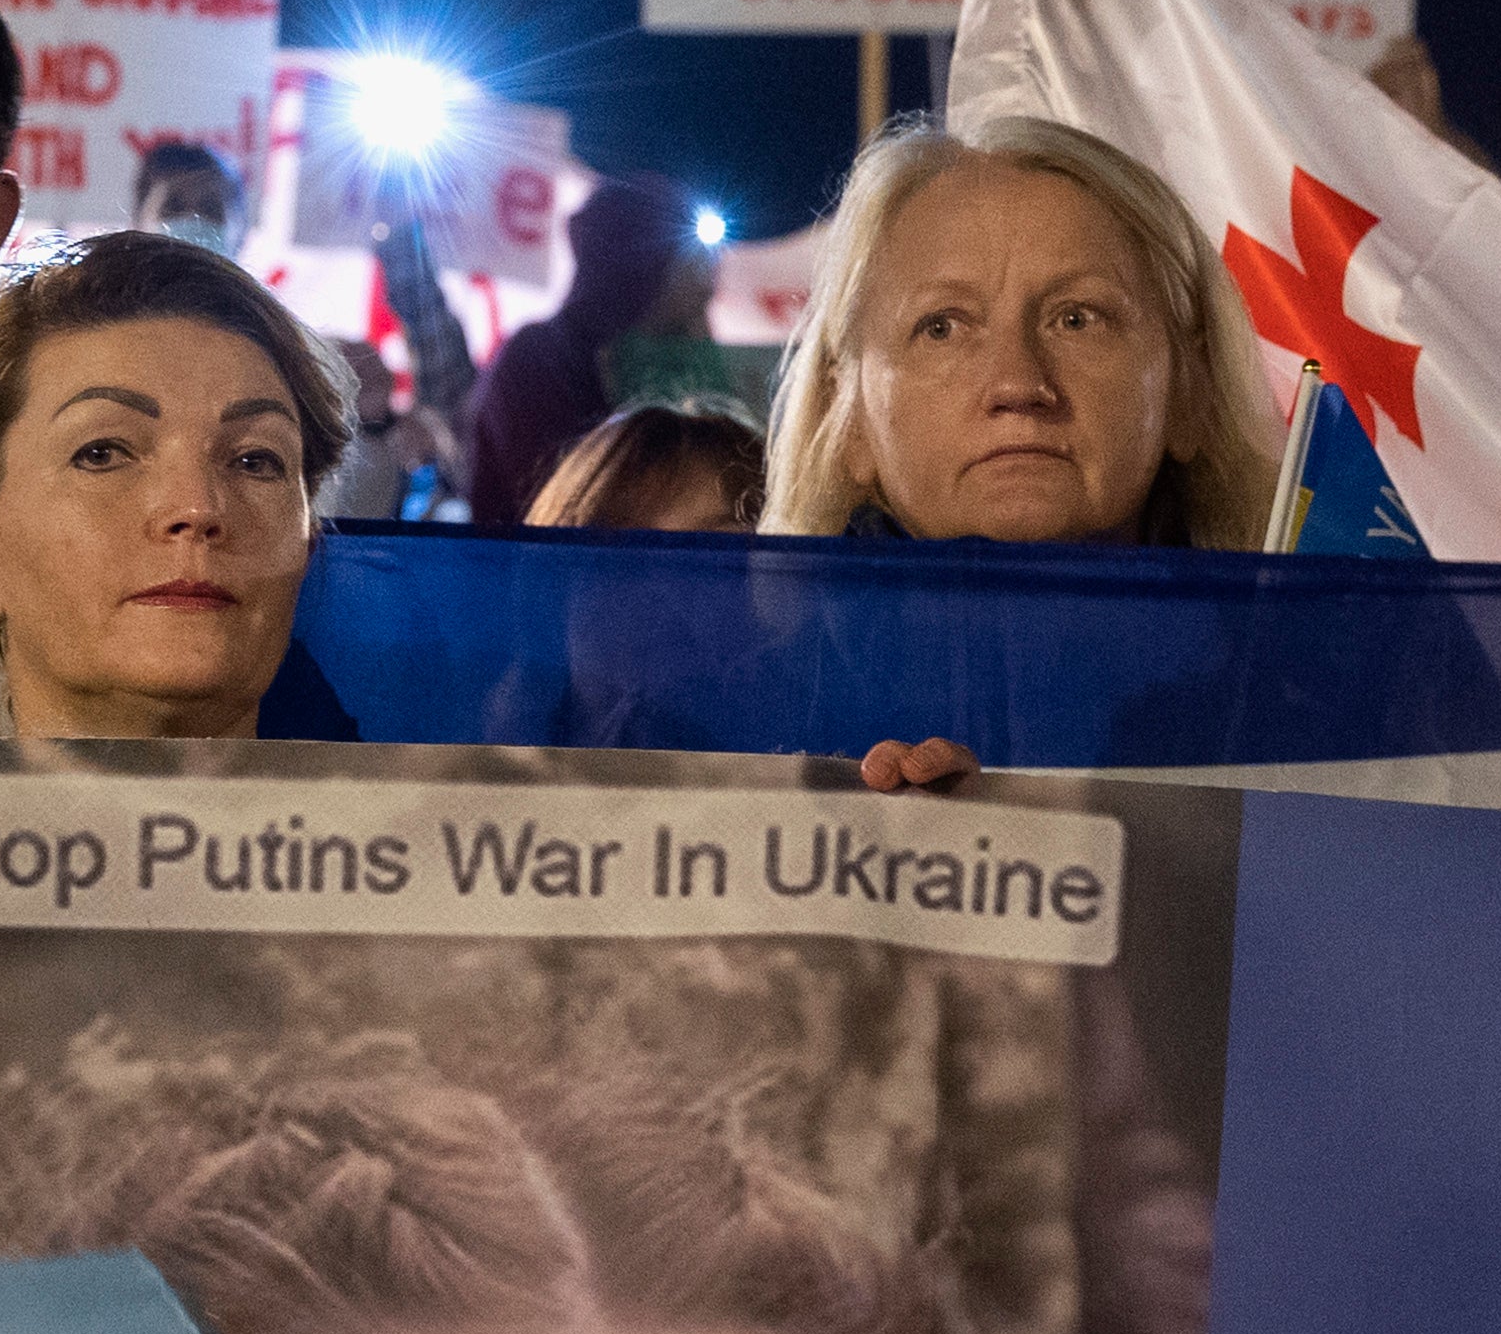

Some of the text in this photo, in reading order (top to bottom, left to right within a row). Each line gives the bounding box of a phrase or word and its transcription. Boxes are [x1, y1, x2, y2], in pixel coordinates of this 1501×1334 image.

[138, 811, 411, 896] Putins
[441, 821, 623, 898] War
[652, 823, 729, 899] In
[763, 823, 1103, 925] Ukraine
